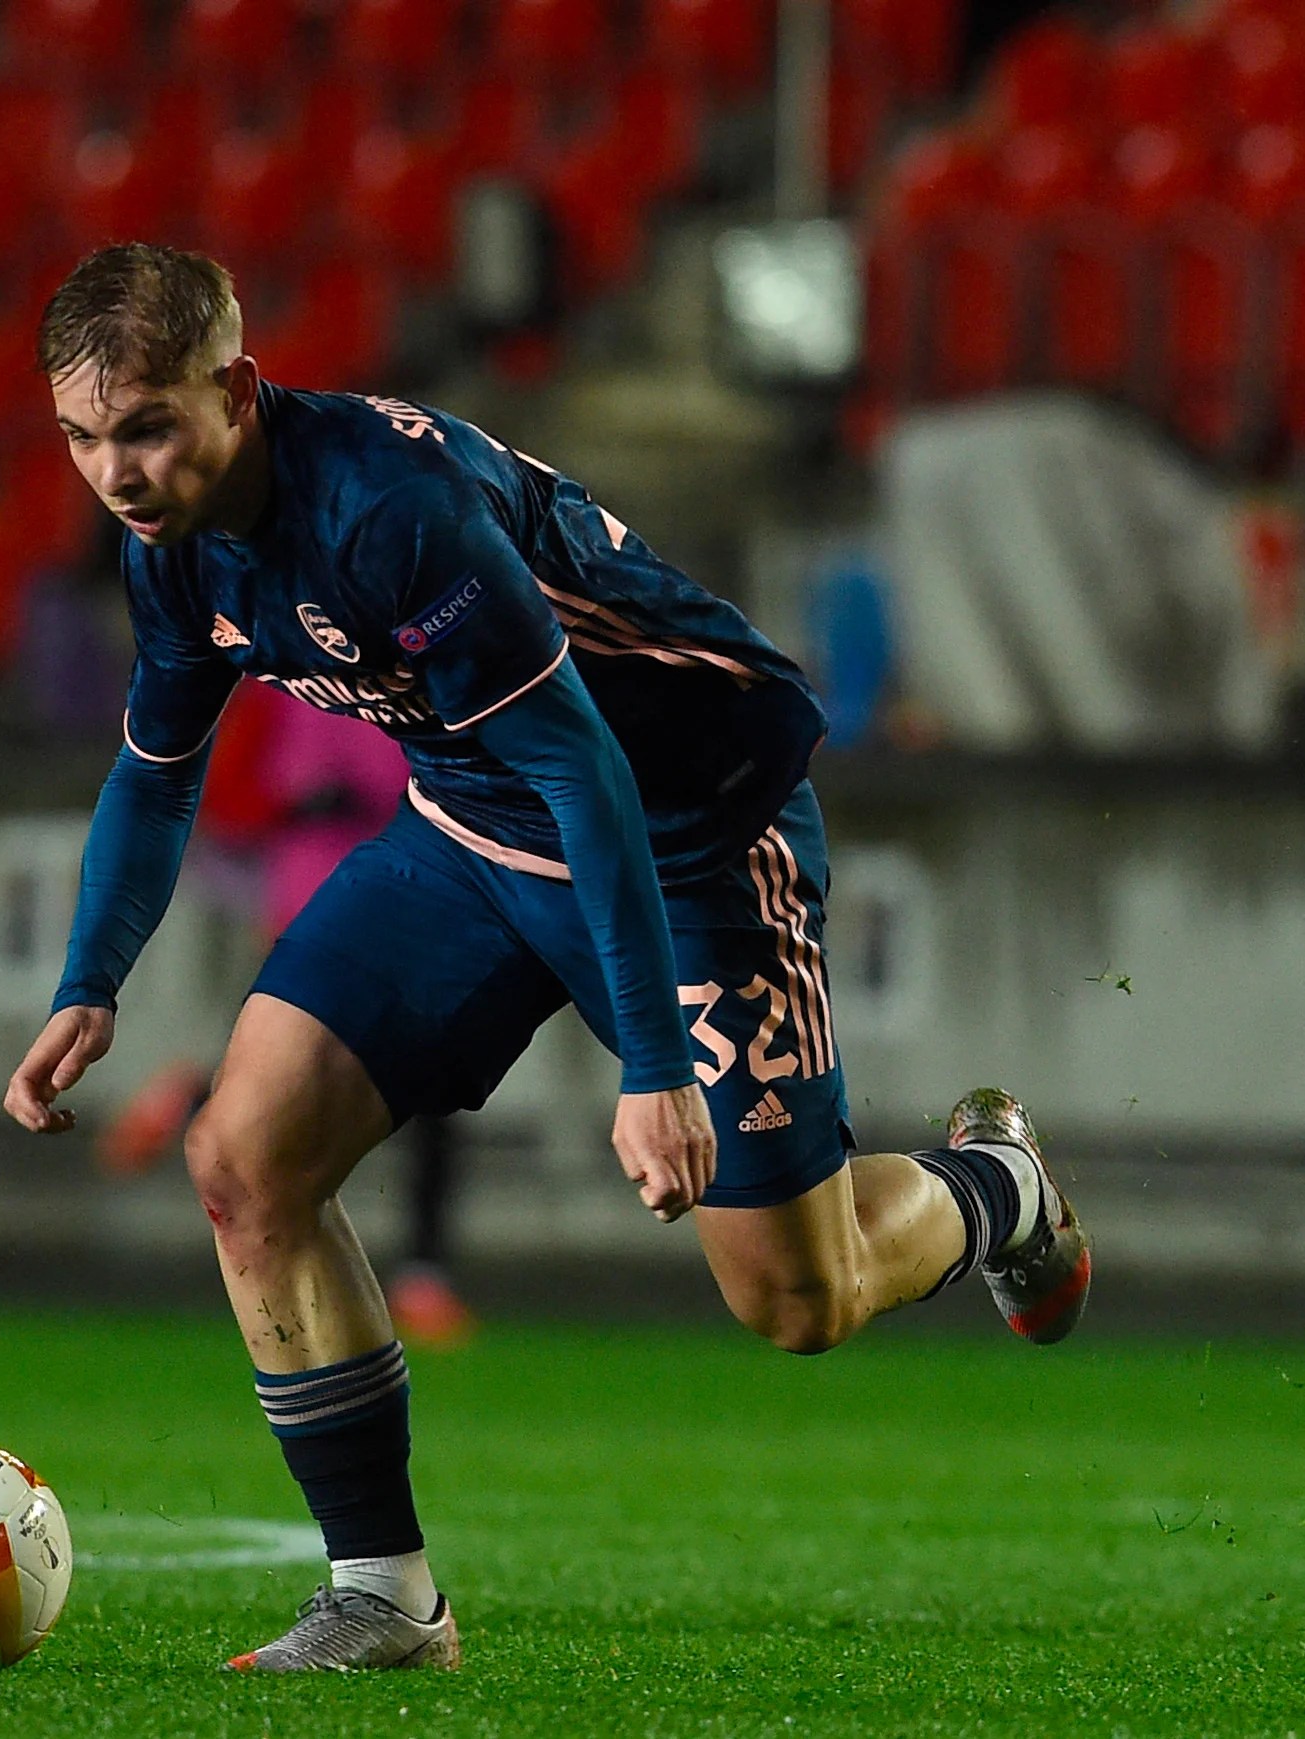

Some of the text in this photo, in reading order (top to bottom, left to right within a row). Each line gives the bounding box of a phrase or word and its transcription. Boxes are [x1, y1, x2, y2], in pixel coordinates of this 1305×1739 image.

[422, 577, 482, 636] RESPECT
[677, 974, 799, 1087] 32
[738, 1112, 793, 1133] adidas
